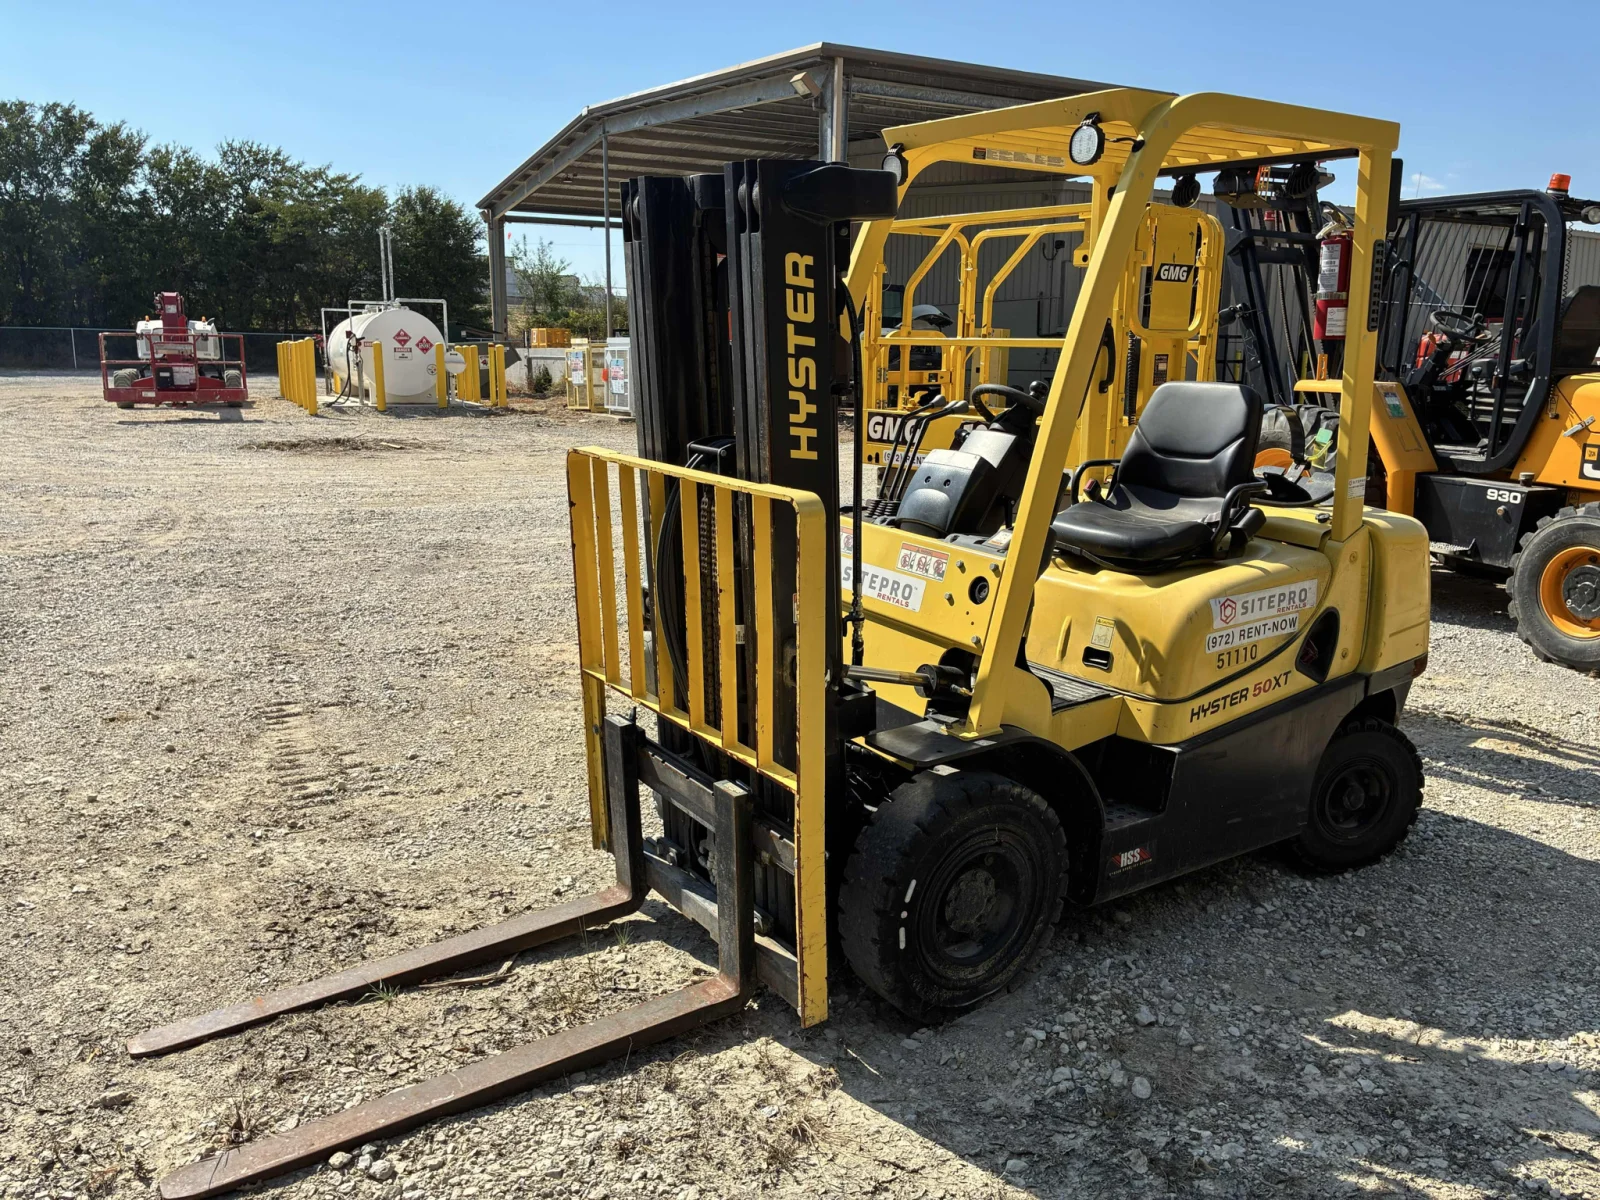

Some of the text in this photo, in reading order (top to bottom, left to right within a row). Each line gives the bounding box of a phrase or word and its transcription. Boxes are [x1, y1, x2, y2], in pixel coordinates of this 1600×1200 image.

[1160, 265, 1188, 281] GMG
[785, 252, 818, 460] HYSTER
[868, 415, 922, 443] GMG
[884, 452, 903, 464] (92)
[1486, 488, 1521, 504] 930
[843, 566, 913, 601] STEPRO
[876, 592, 909, 608] RENTALS
[1241, 587, 1308, 616] SITEPRO
[1276, 603, 1307, 614] RENTALS
[1207, 616, 1298, 651] (972) RENT-NOW
[1216, 644, 1258, 670] 51110
[1190, 670, 1292, 723] HYSTER 50XT
[1120, 848, 1141, 868] HSS
